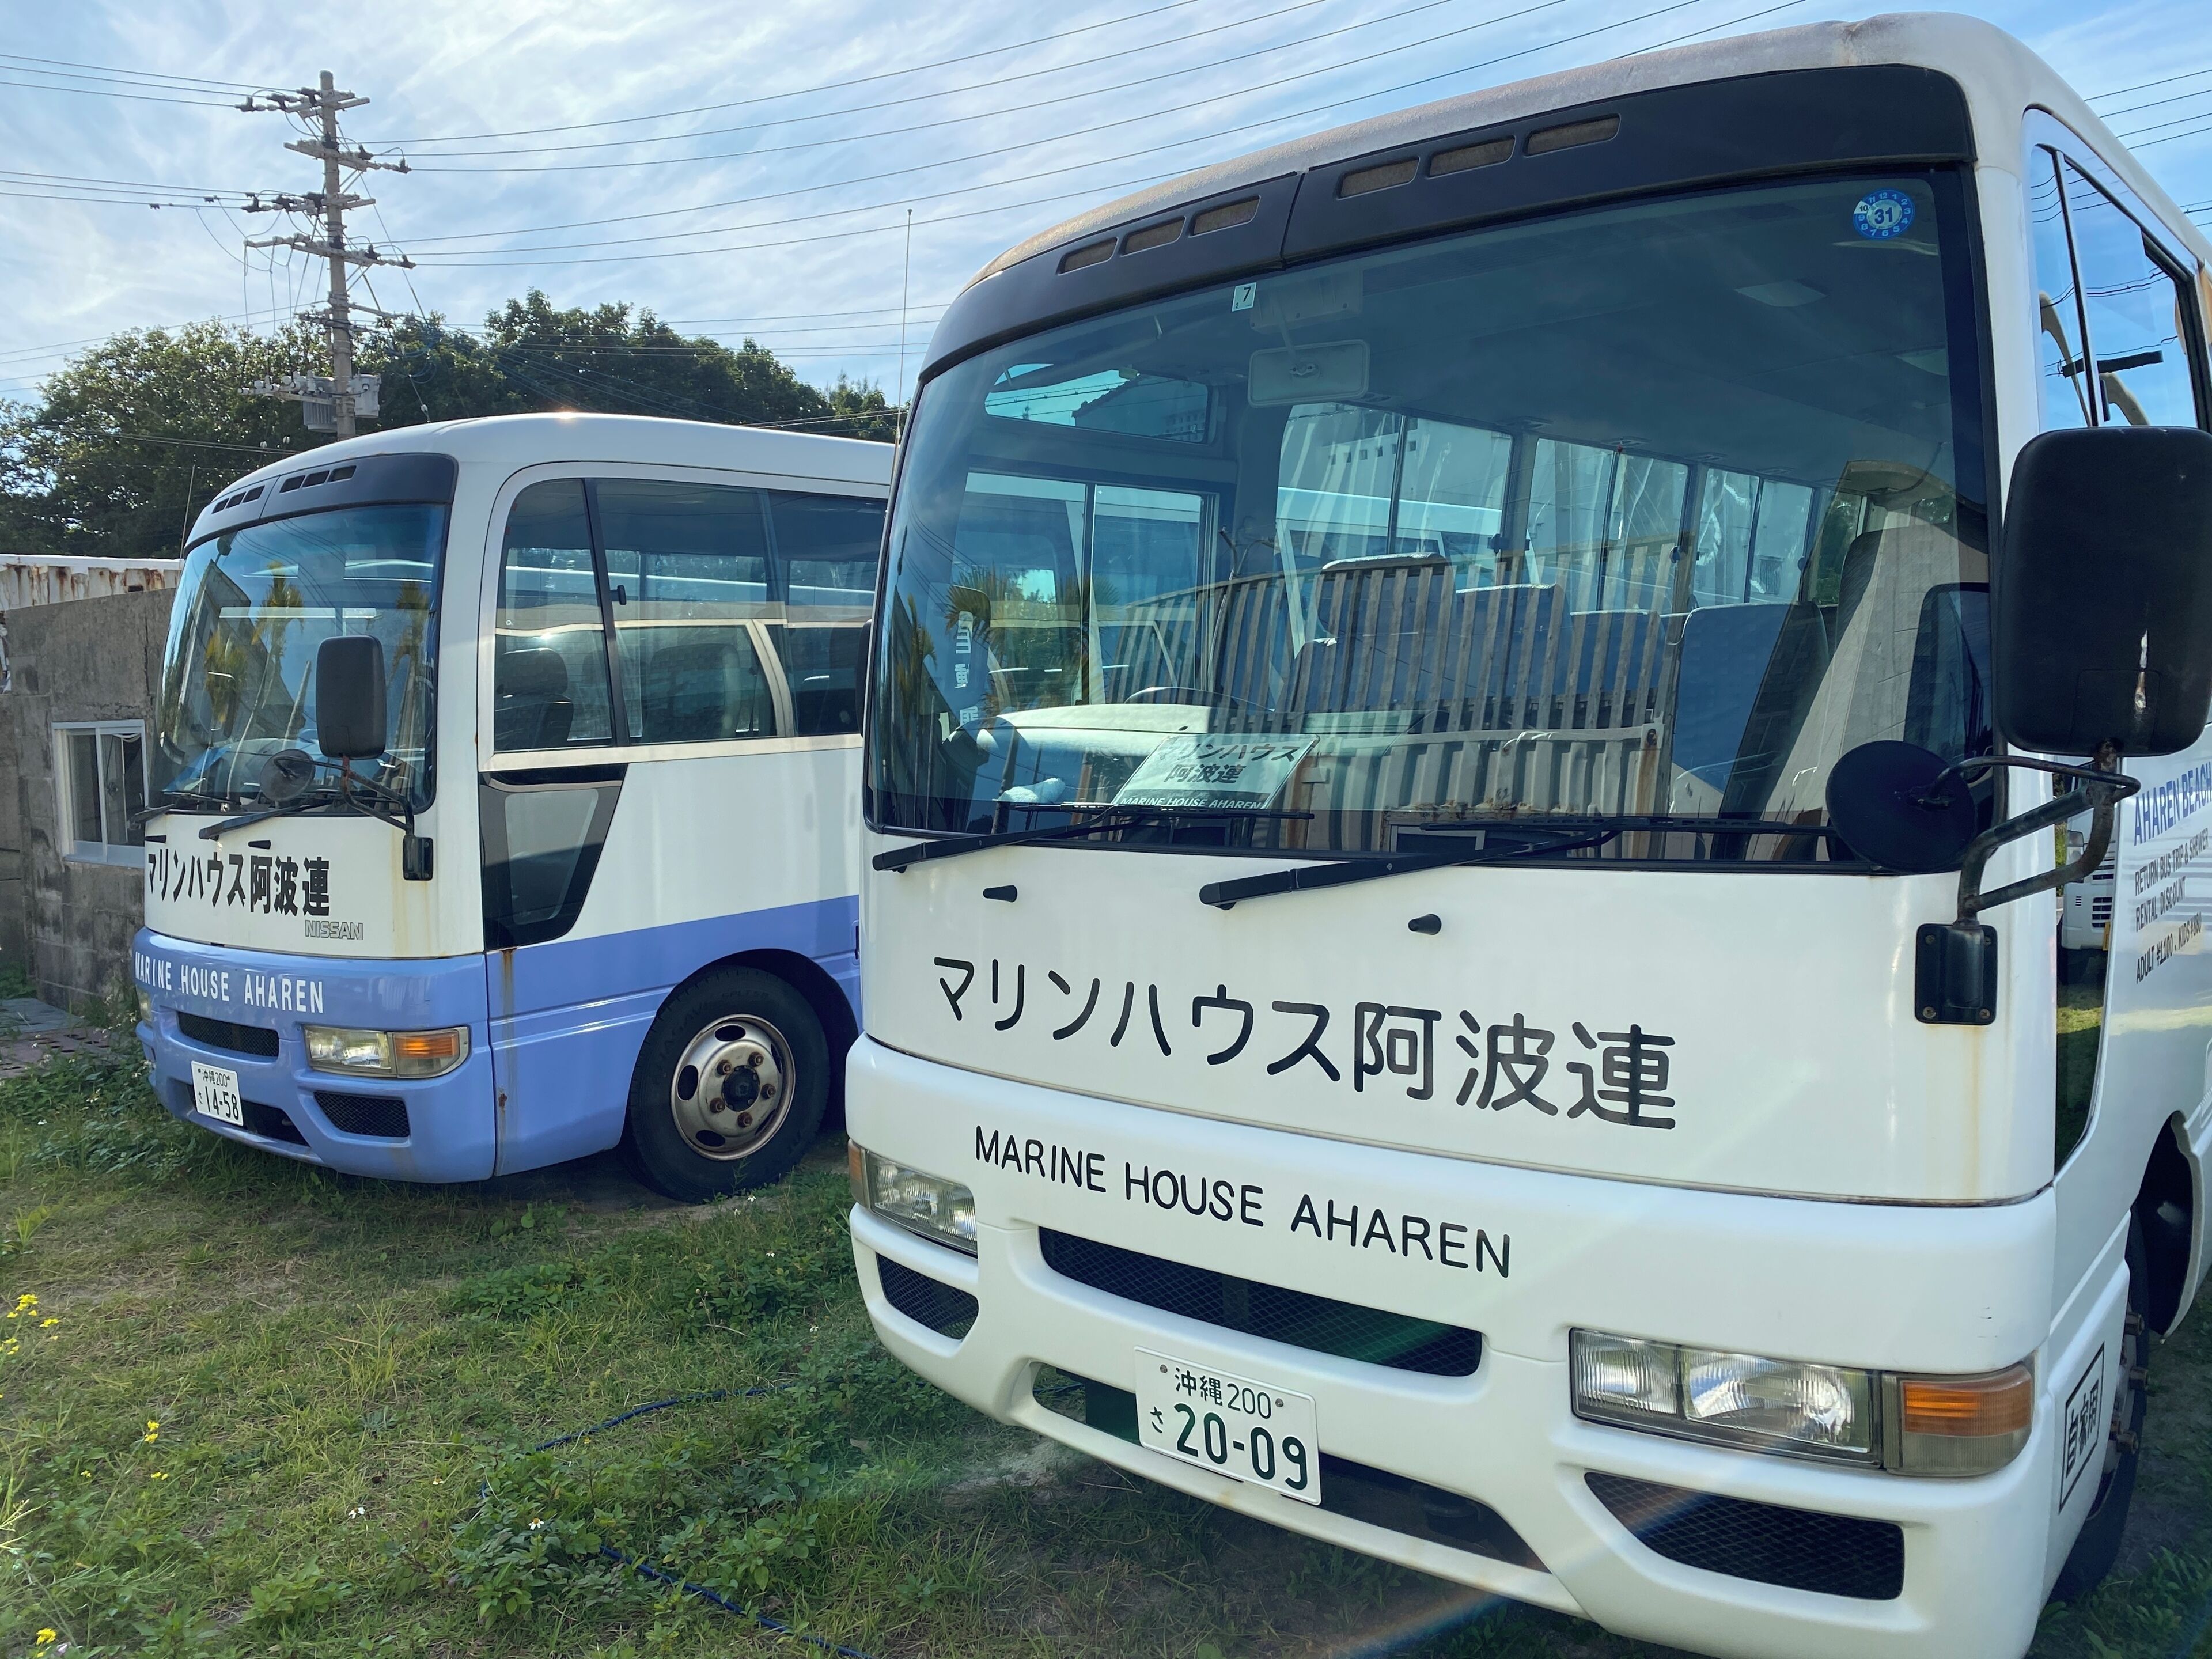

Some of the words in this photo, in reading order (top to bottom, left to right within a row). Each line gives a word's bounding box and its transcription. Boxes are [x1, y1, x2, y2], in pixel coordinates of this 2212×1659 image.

[1874, 207, 1893, 224] 31
[1243, 286, 1251, 302] 7
[1164, 763, 1247, 783] 阿波連
[1120, 797, 1165, 806] MARINE
[1166, 798, 1207, 807] HOUSE
[1208, 800, 1262, 809] AHAREN
[2134, 778, 2180, 846] AHAREN
[2181, 761, 2212, 818] BEACH
[148, 848, 329, 916] マリンハウス阿波連
[2135, 859, 2158, 896] RETURN
[2160, 853, 2171, 880] BUS
[2172, 844, 2183, 872] TRIP
[305, 920, 363, 941] NISSAN
[2136, 896, 2158, 933] RENTAL
[2160, 876, 2186, 915] DISCOUNT
[2137, 945, 2154, 984] ADULT
[2179, 920, 2190, 950] KIDS
[135, 951, 172, 991] MARINE
[181, 965, 230, 1002] HOUSE
[244, 974, 324, 1014] AHAREN
[934, 957, 1675, 1130] マリンハウス阿波連
[205, 1086, 239, 1120] 14-58
[976, 1125, 1106, 1192] MARINE
[1125, 1161, 1264, 1227] HOUSE
[1290, 1194, 1510, 1278] AHAREN
[1175, 1366, 1272, 1419] 沖縄200
[1150, 1406, 1164, 1434] さ
[1173, 1403, 1308, 1491] 20-09
[2066, 1378, 2099, 1479] 自家用
